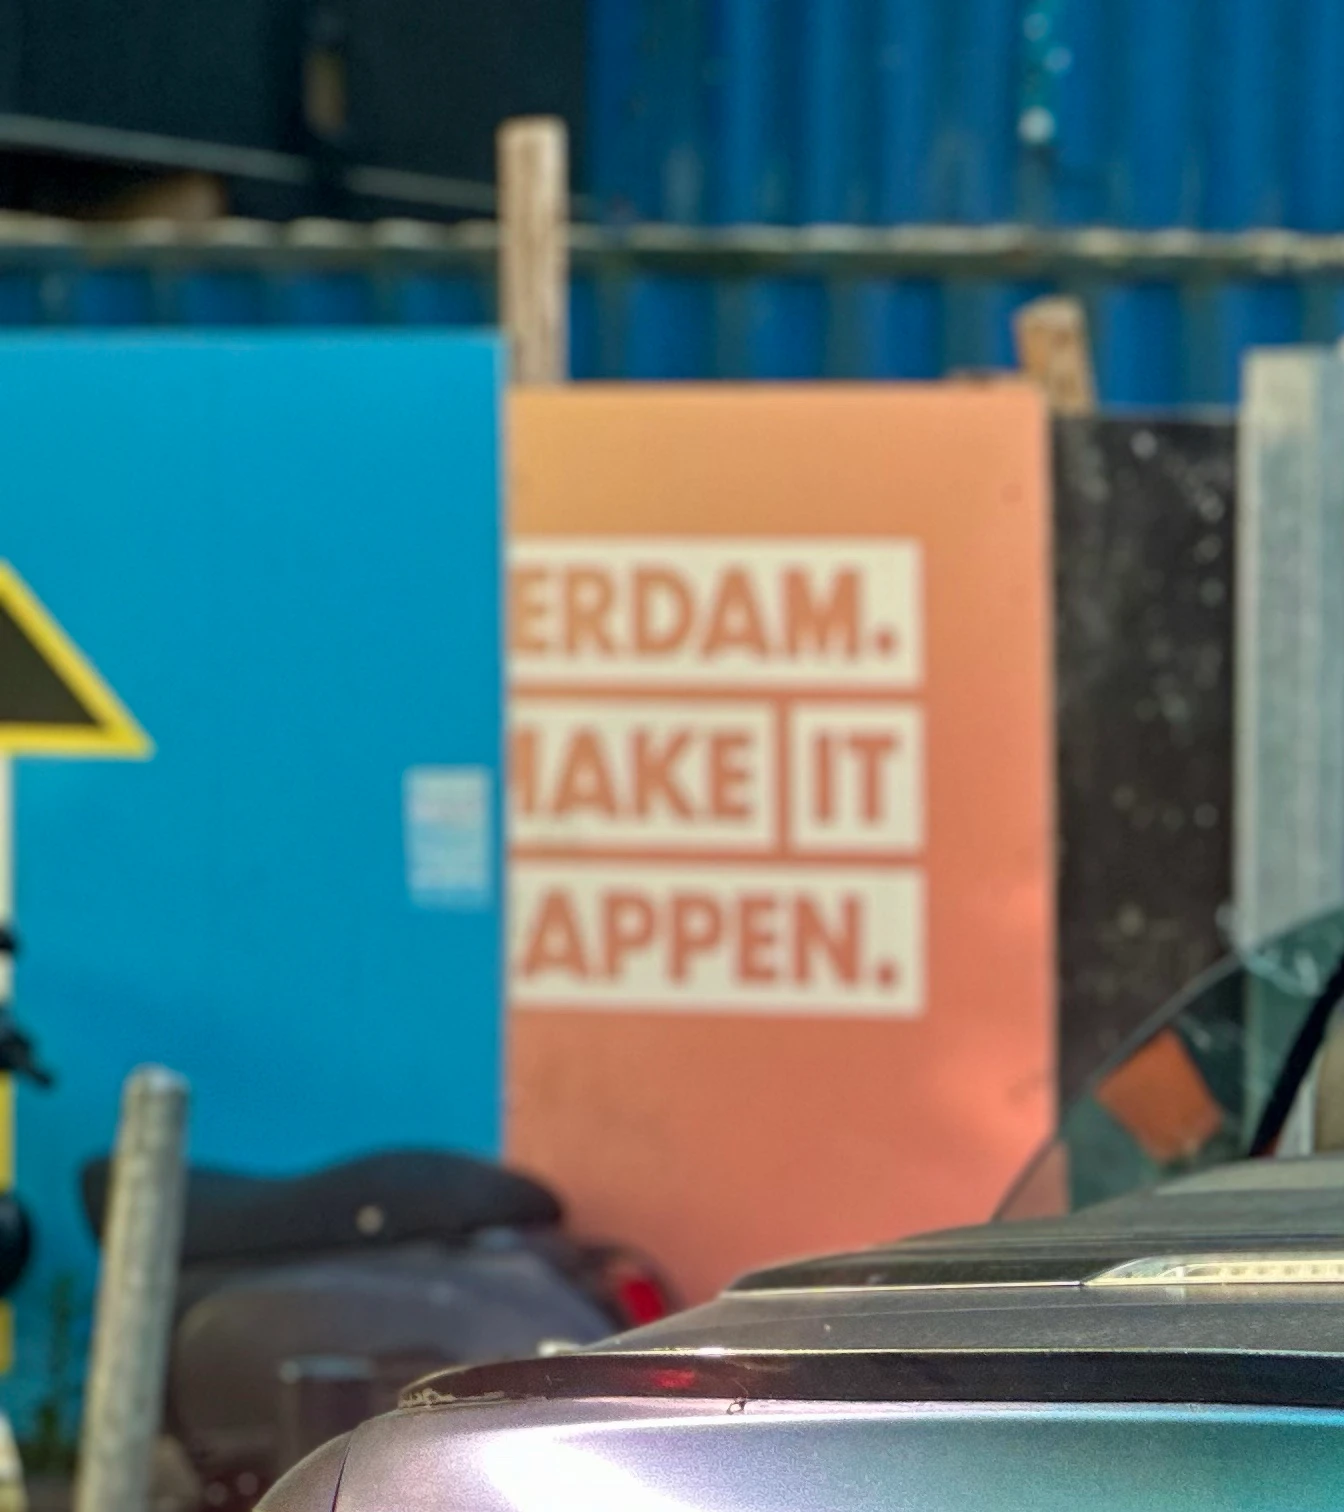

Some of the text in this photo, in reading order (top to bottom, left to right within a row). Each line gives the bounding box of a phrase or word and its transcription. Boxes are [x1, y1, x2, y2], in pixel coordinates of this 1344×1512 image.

[508, 561, 897, 660] ERDAM.
[813, 727, 905, 828] IT
[520, 887, 900, 987] APPEN.
